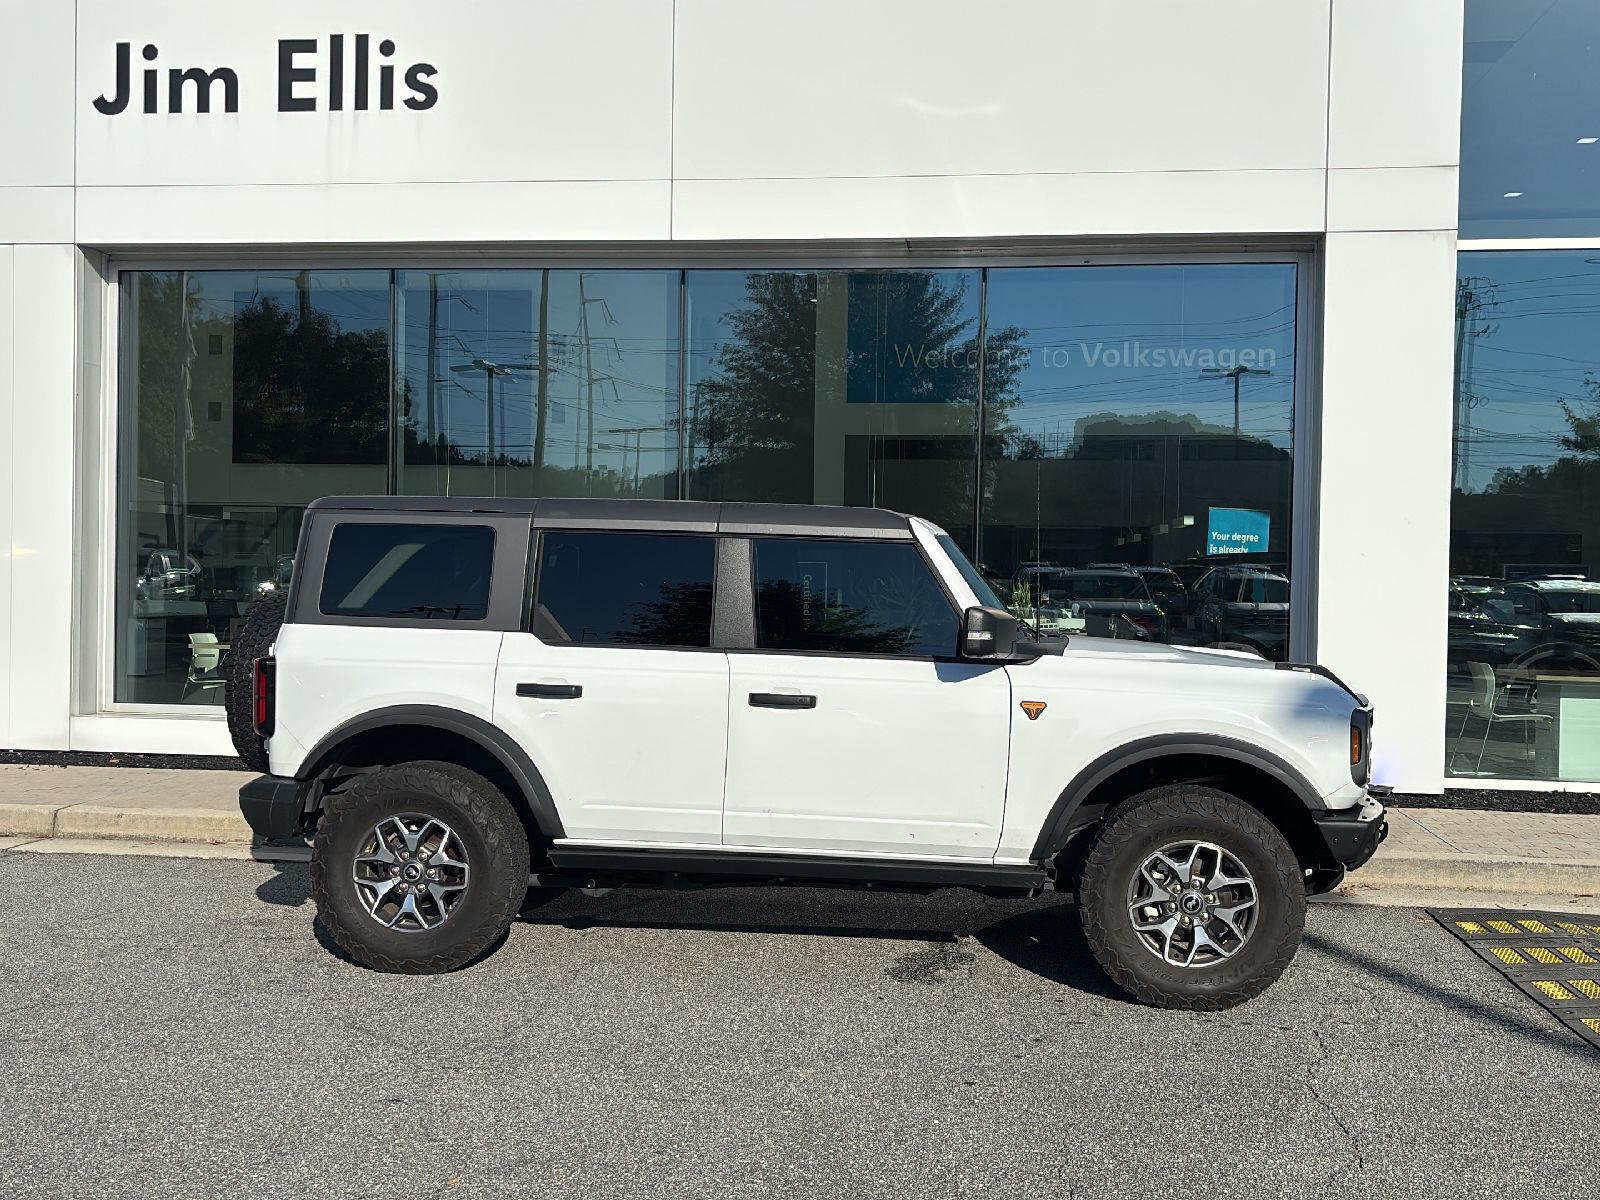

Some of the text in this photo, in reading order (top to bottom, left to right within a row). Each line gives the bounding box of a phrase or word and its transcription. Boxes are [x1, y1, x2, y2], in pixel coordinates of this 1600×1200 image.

[92, 34, 439, 115] Jim Ellis
[1042, 346, 1070, 368] to
[1080, 341, 1277, 368] Volkswagen
[1211, 531, 1259, 544] Your degree
[1209, 543, 1217, 554] is
